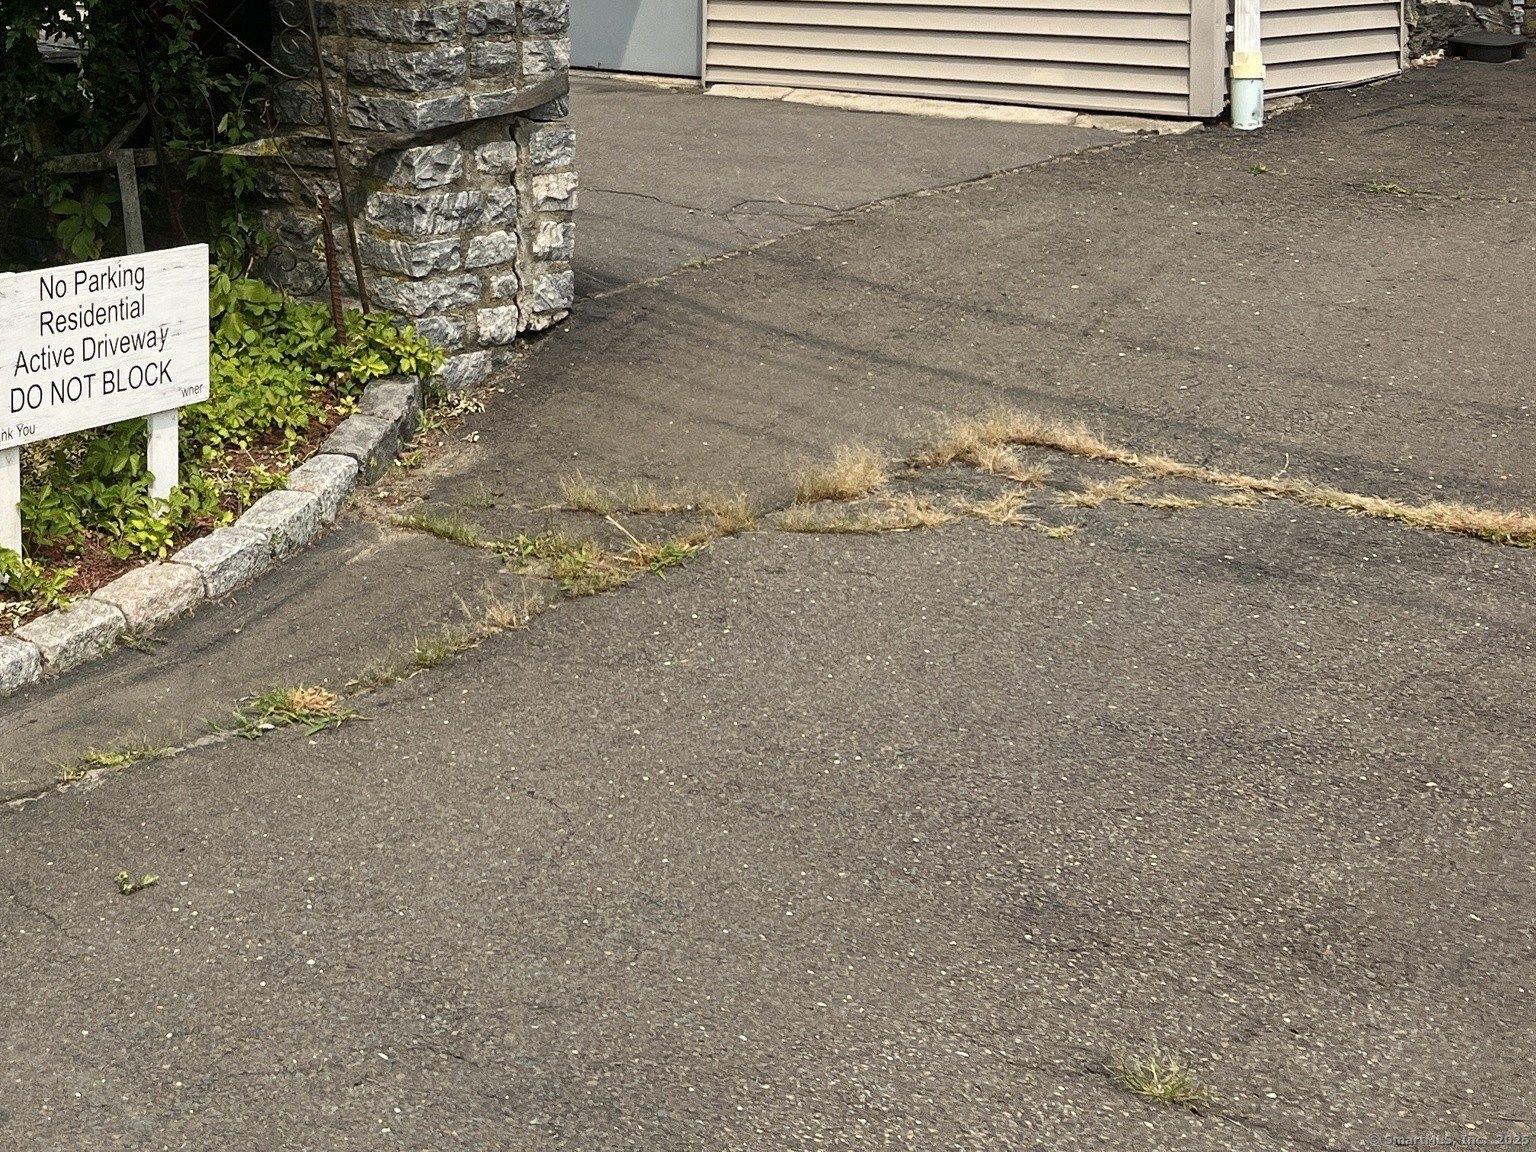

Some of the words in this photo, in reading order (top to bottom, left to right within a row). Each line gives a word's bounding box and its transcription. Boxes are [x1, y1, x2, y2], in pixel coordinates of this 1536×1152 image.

[40, 275, 66, 301] No
[75, 265, 145, 295] Parking
[40, 294, 145, 336] Residential
[14, 345, 75, 376] Active
[82, 327, 169, 362] Driveway
[11, 384, 42, 413] DO
[51, 373, 96, 405] NOT
[103, 359, 172, 395] BLOCK
[178, 383, 203, 398] wner
[16, 423, 36, 438] You
